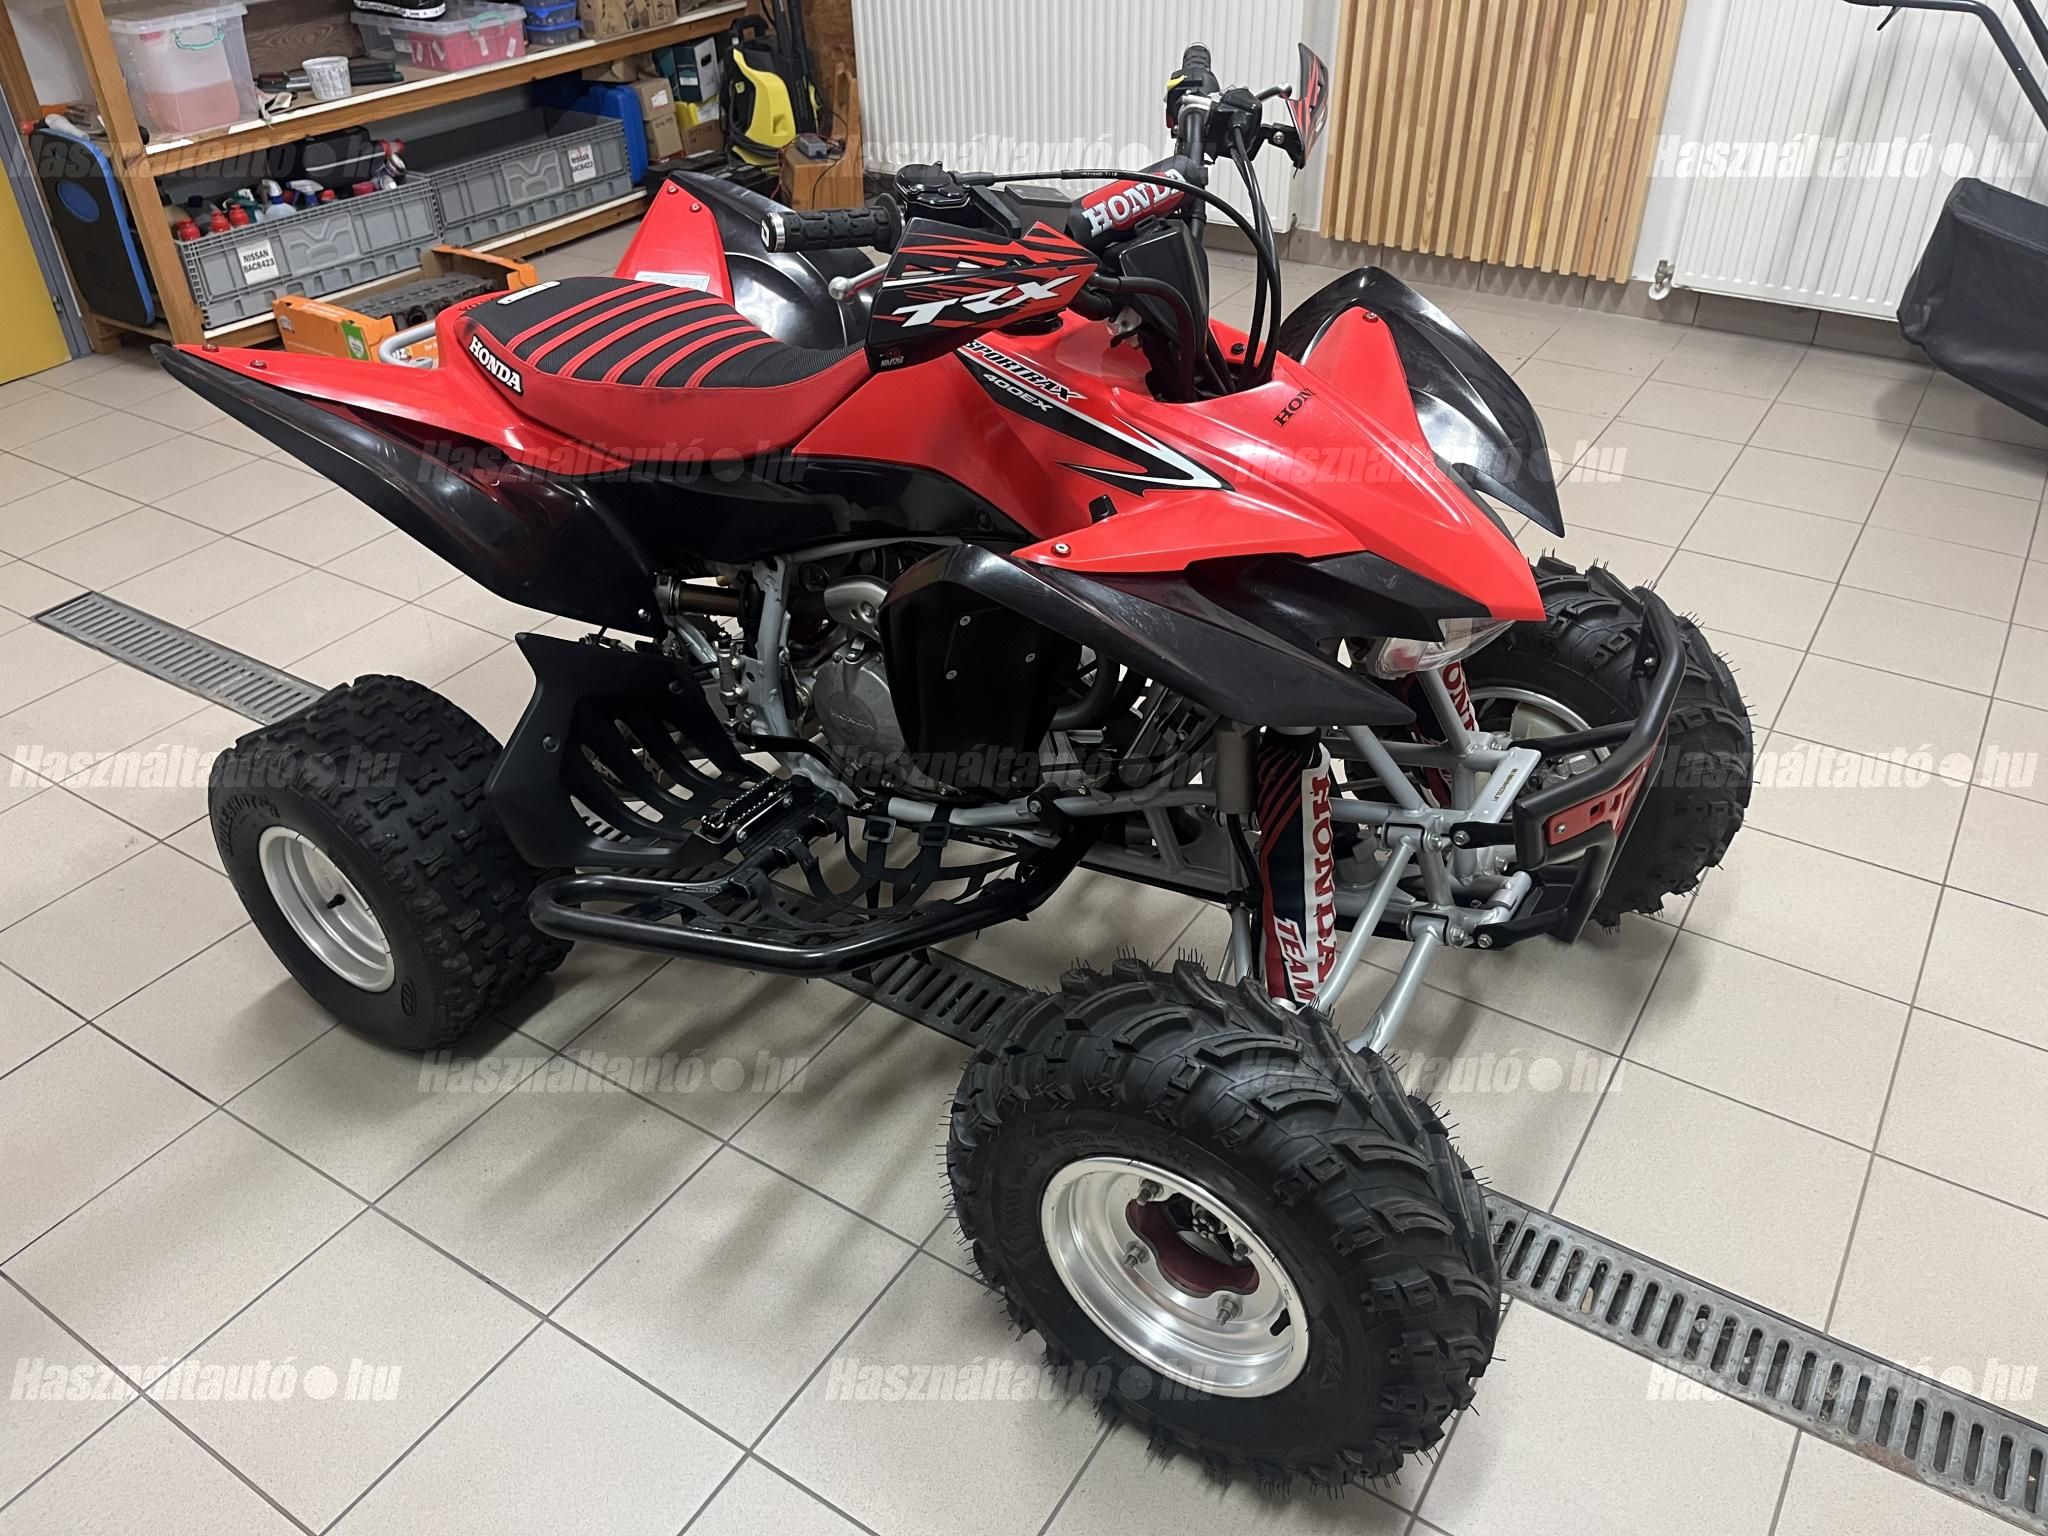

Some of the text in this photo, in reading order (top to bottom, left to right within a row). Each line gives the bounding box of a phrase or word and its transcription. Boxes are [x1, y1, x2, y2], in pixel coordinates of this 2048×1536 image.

[891, 274, 1080, 328] TRX
[469, 335, 522, 393] HONDA
[964, 339, 1088, 402] SPORTRAX
[983, 373, 1053, 412] 400EX
[1312, 775, 1338, 984] HONDA
[1277, 921, 1317, 1003] TEAM
